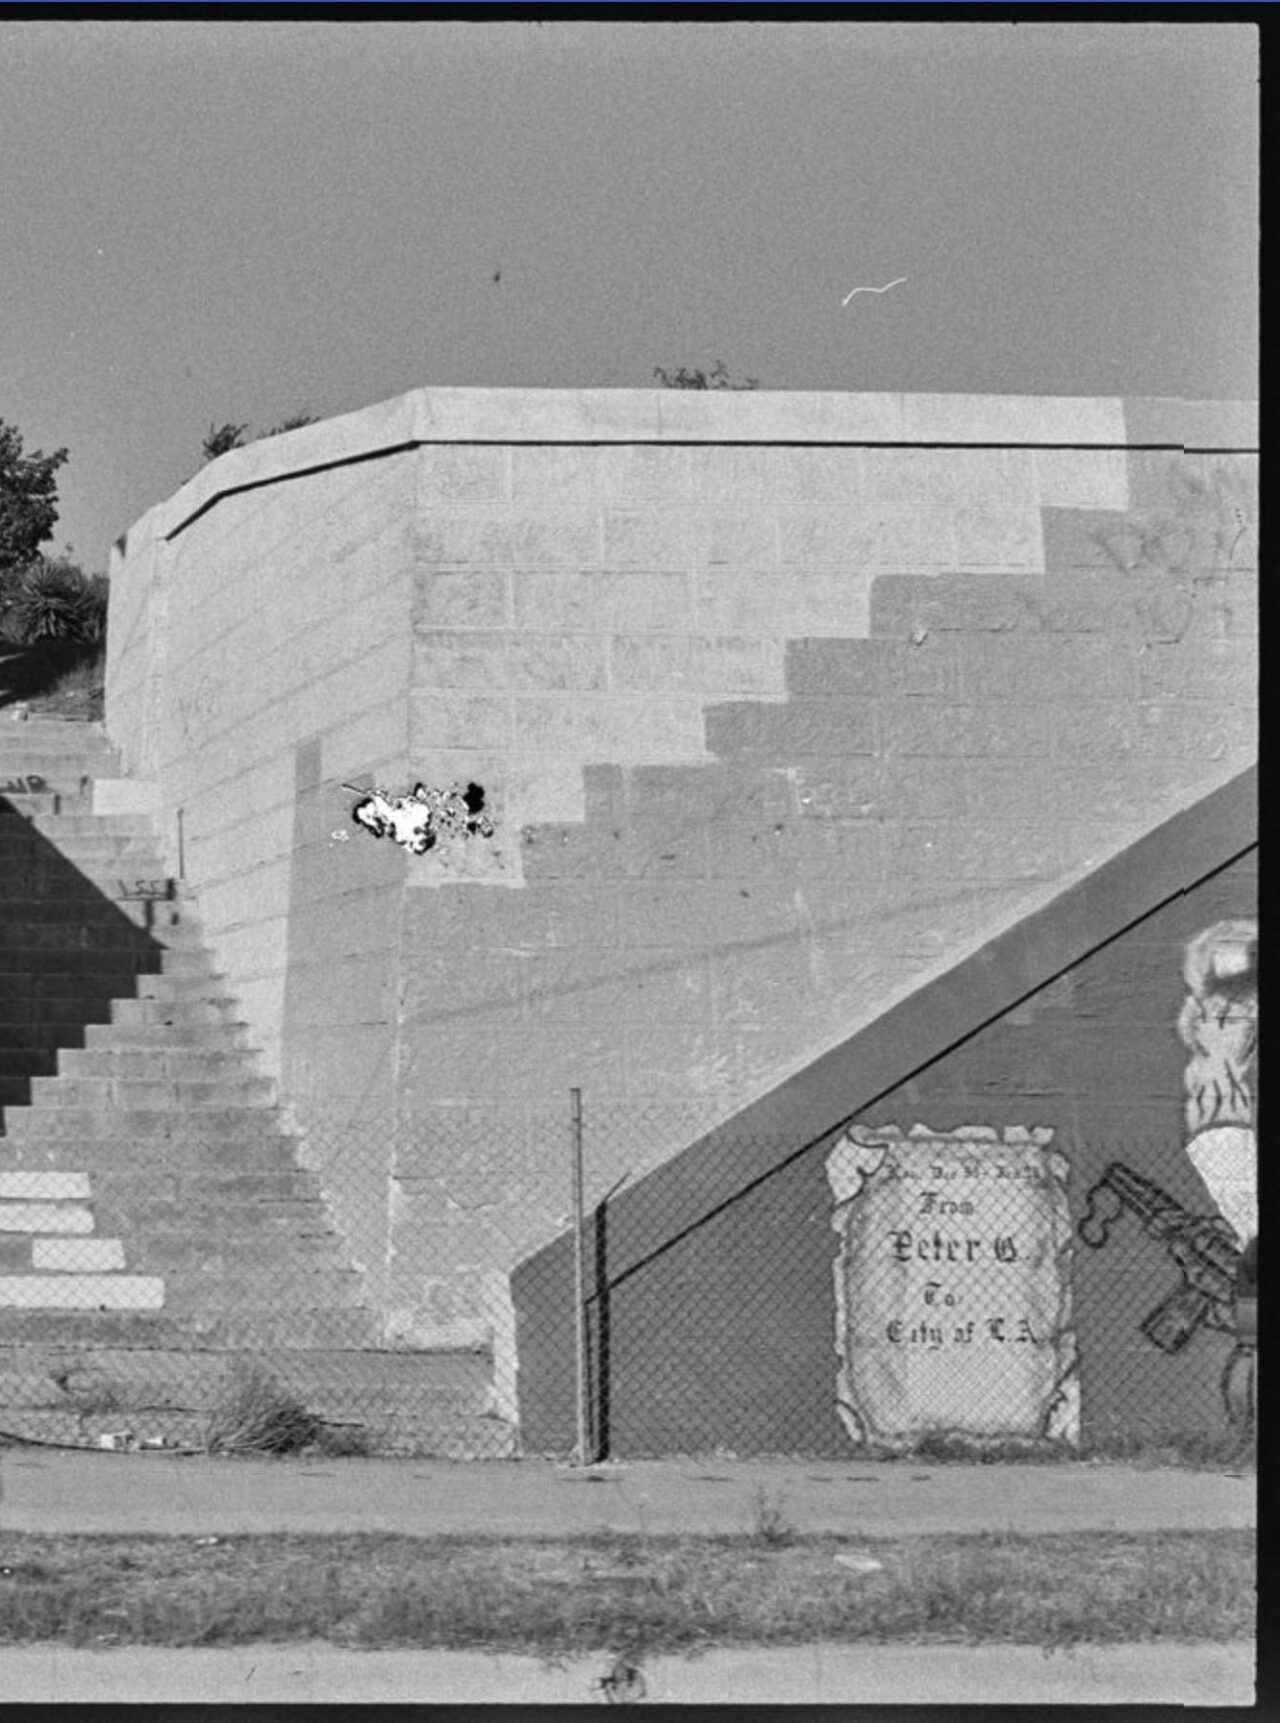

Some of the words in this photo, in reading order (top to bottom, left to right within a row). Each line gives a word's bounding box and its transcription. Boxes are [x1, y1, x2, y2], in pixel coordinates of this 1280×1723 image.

[920, 1191, 976, 1216] From
[887, 1230, 981, 1262] Peter
[924, 1281, 956, 1306] To
[885, 1318, 944, 1350] City
[954, 1320, 976, 1343] of
